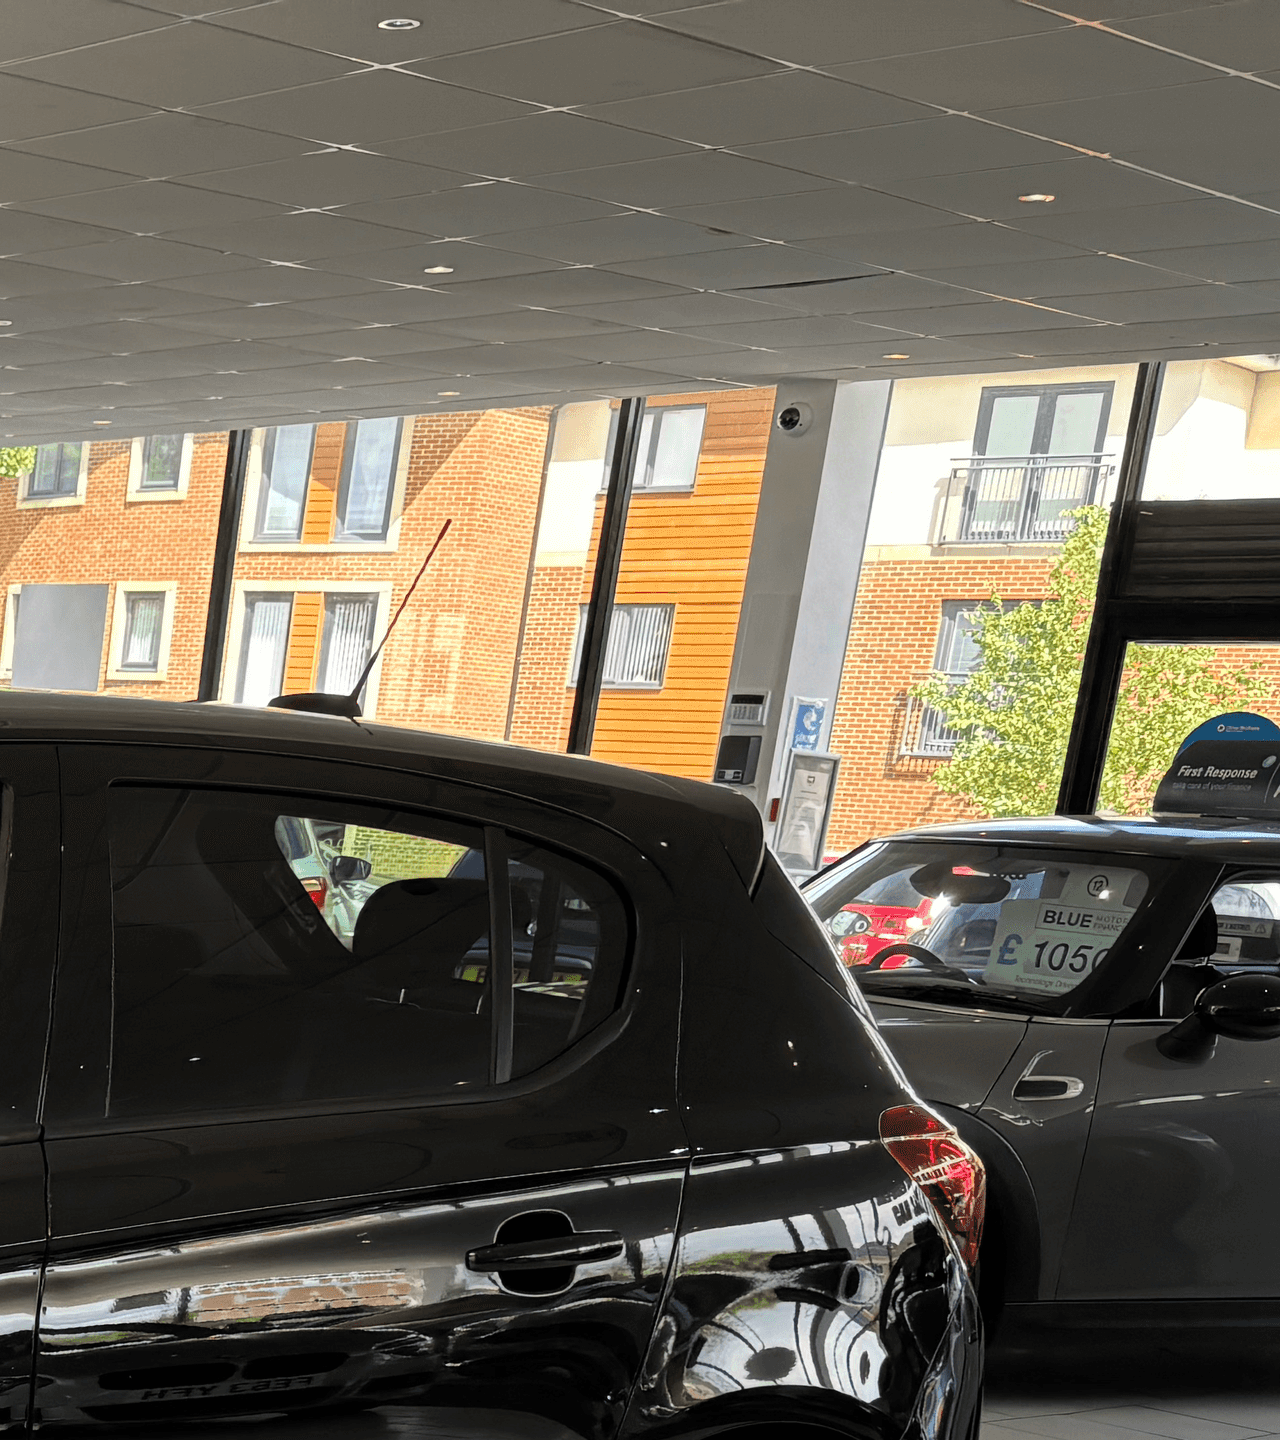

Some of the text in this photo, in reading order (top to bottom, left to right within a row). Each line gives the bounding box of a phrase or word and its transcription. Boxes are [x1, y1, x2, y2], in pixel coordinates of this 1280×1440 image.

[1177, 765, 1258, 780] First Response
[1043, 909, 1094, 928] BLUE
[997, 933, 1023, 966] £
